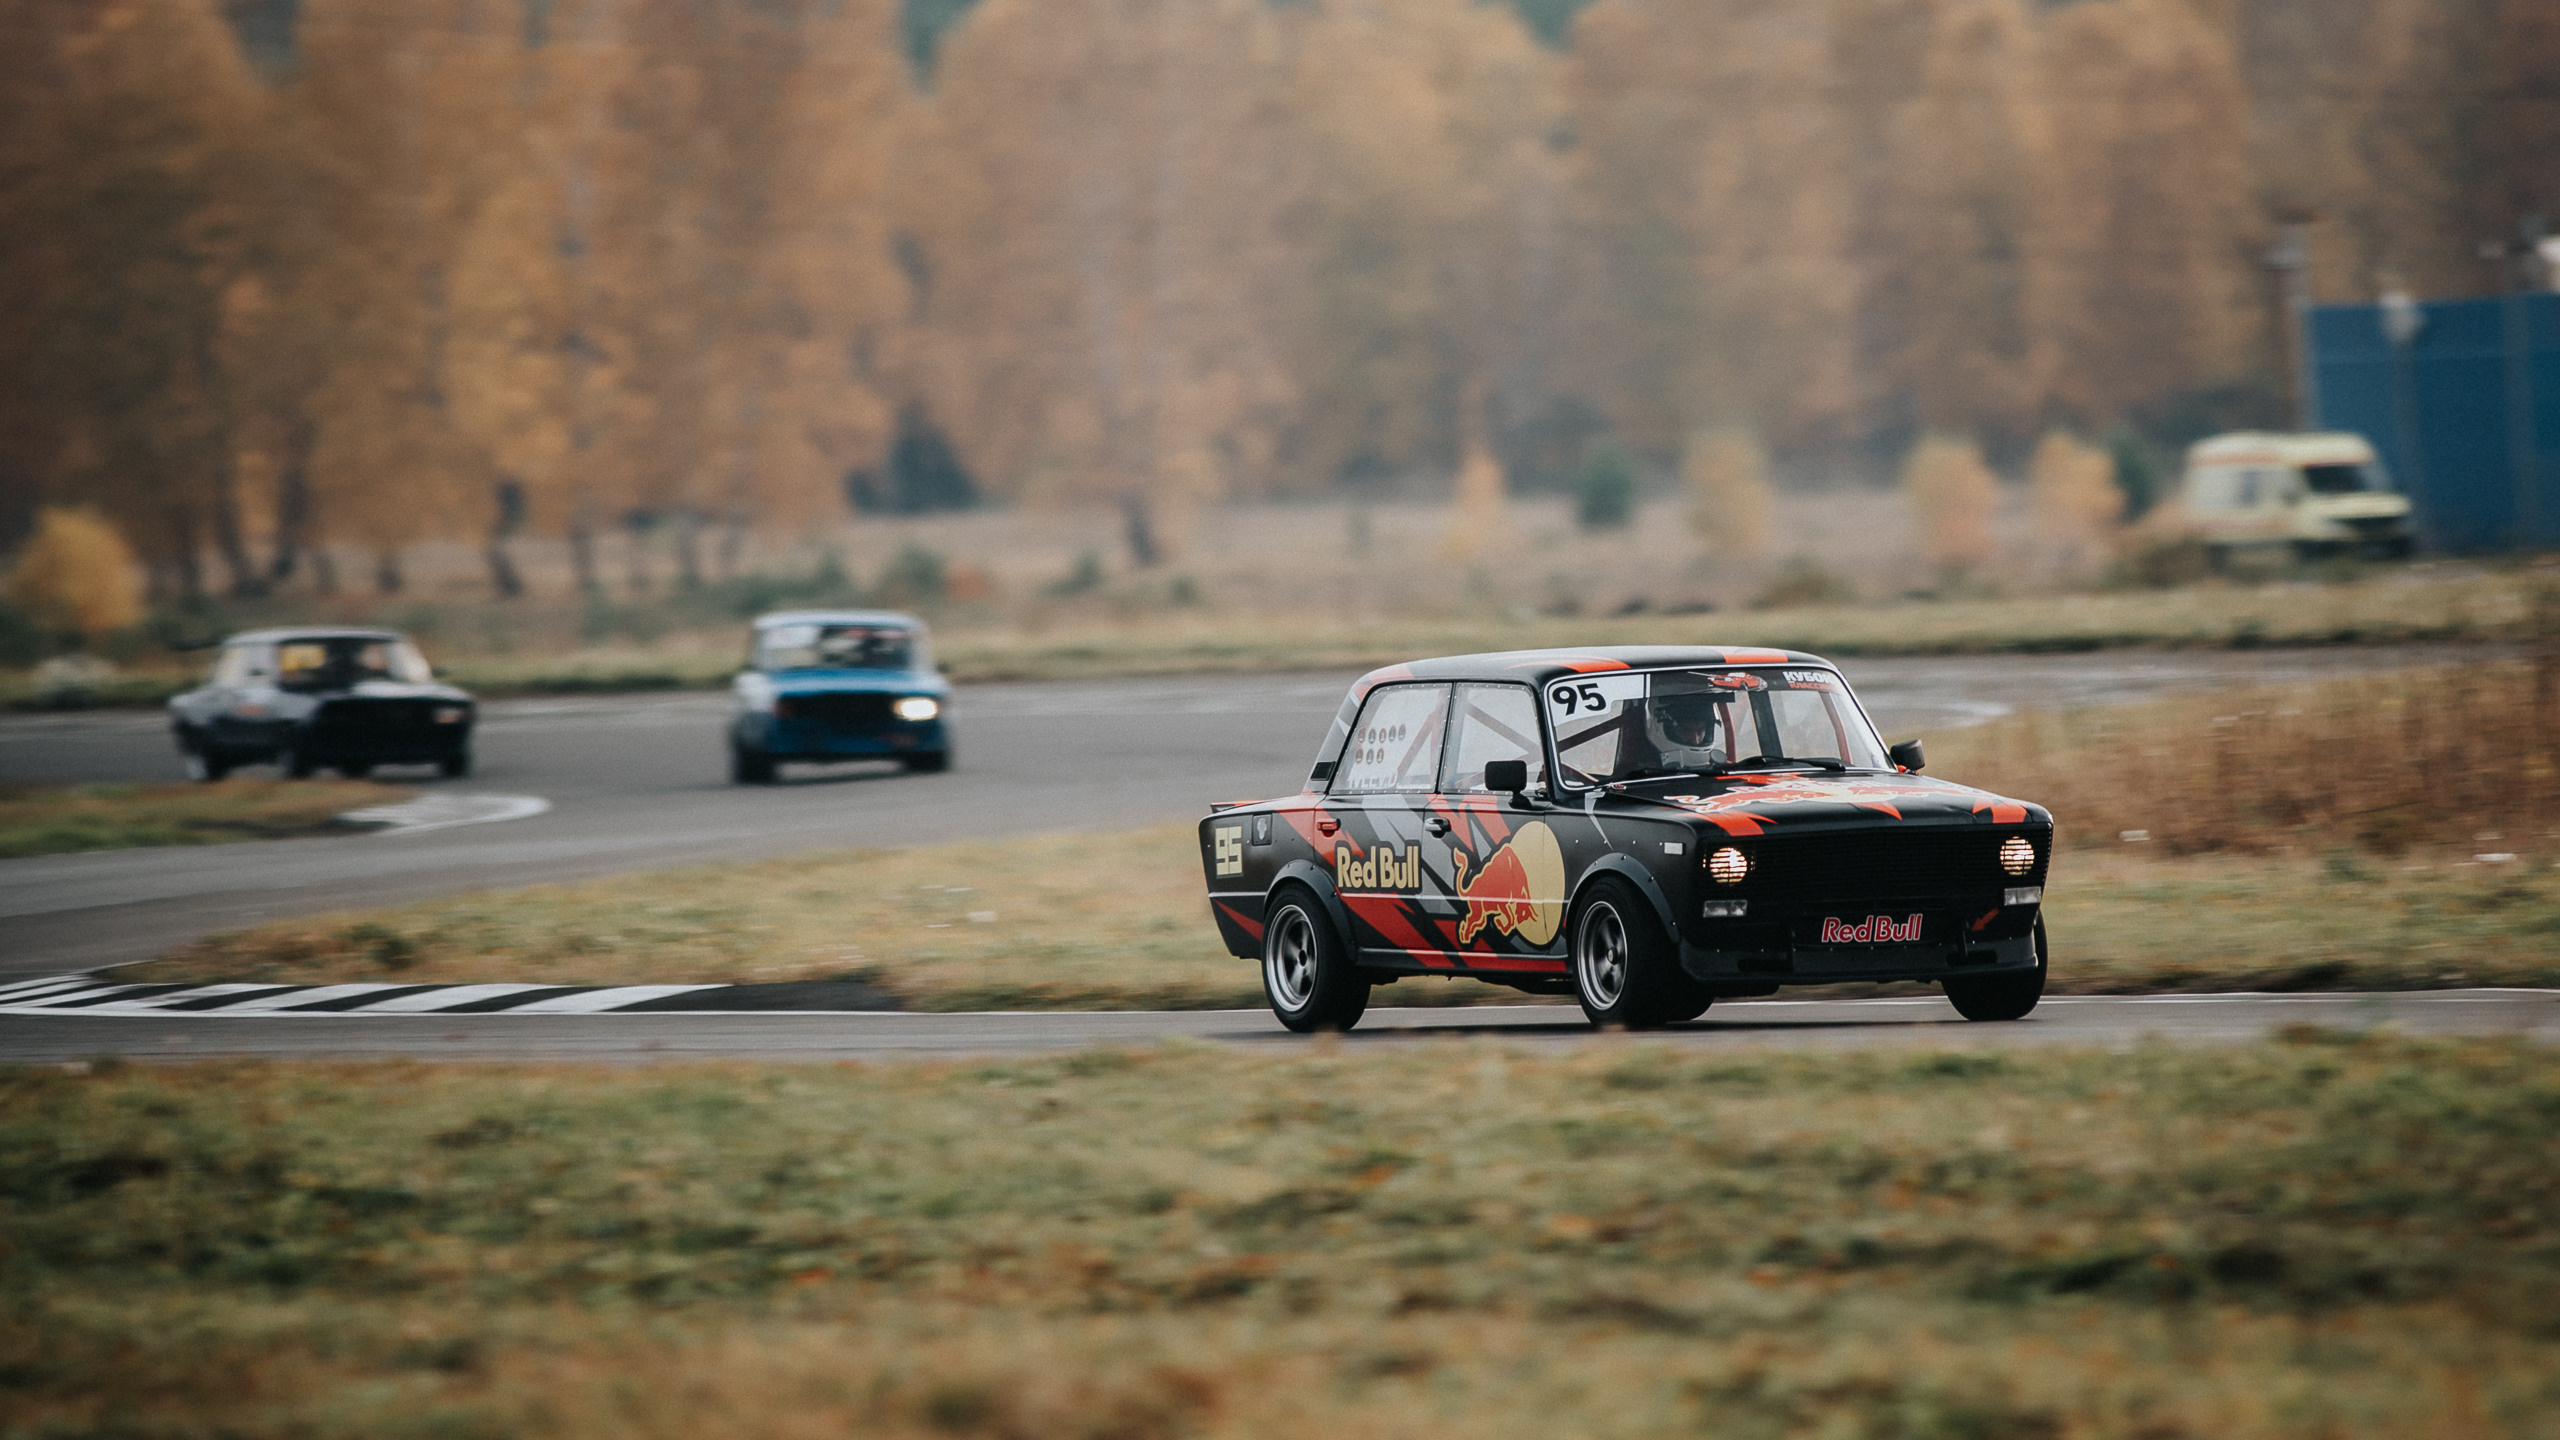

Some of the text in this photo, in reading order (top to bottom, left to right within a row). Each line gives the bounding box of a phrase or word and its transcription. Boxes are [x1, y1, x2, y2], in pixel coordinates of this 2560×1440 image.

[1552, 683, 1606, 716] 95
[1215, 826, 1242, 876] 95
[1337, 846, 1420, 889] Red Bull
[1821, 913, 1923, 943] Red Bull
